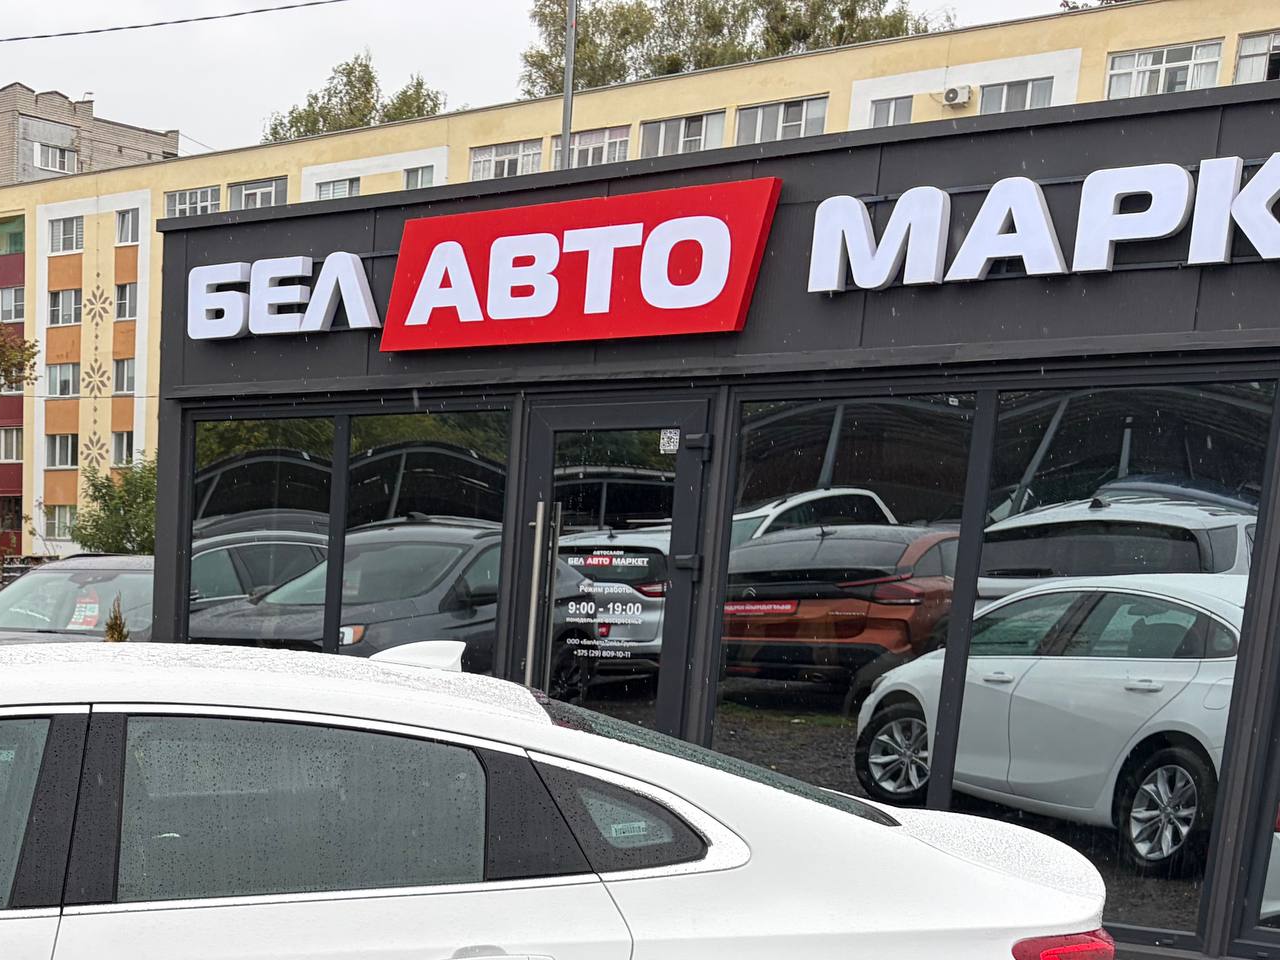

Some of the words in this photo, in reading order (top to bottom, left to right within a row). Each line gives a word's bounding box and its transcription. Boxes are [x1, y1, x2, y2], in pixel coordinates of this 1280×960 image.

[187, 251, 381, 340] БЕЛ
[404, 215, 732, 326] АВТО
[807, 152, 1280, 293] МАРК
[567, 557, 584, 566] БЕЛ
[586, 557, 610, 566] АВТО
[612, 557, 649, 566] МАРКЕТ
[579, 585, 603, 593] Режим
[568, 601, 596, 615] 9:00
[607, 602, 642, 616] 19:00
